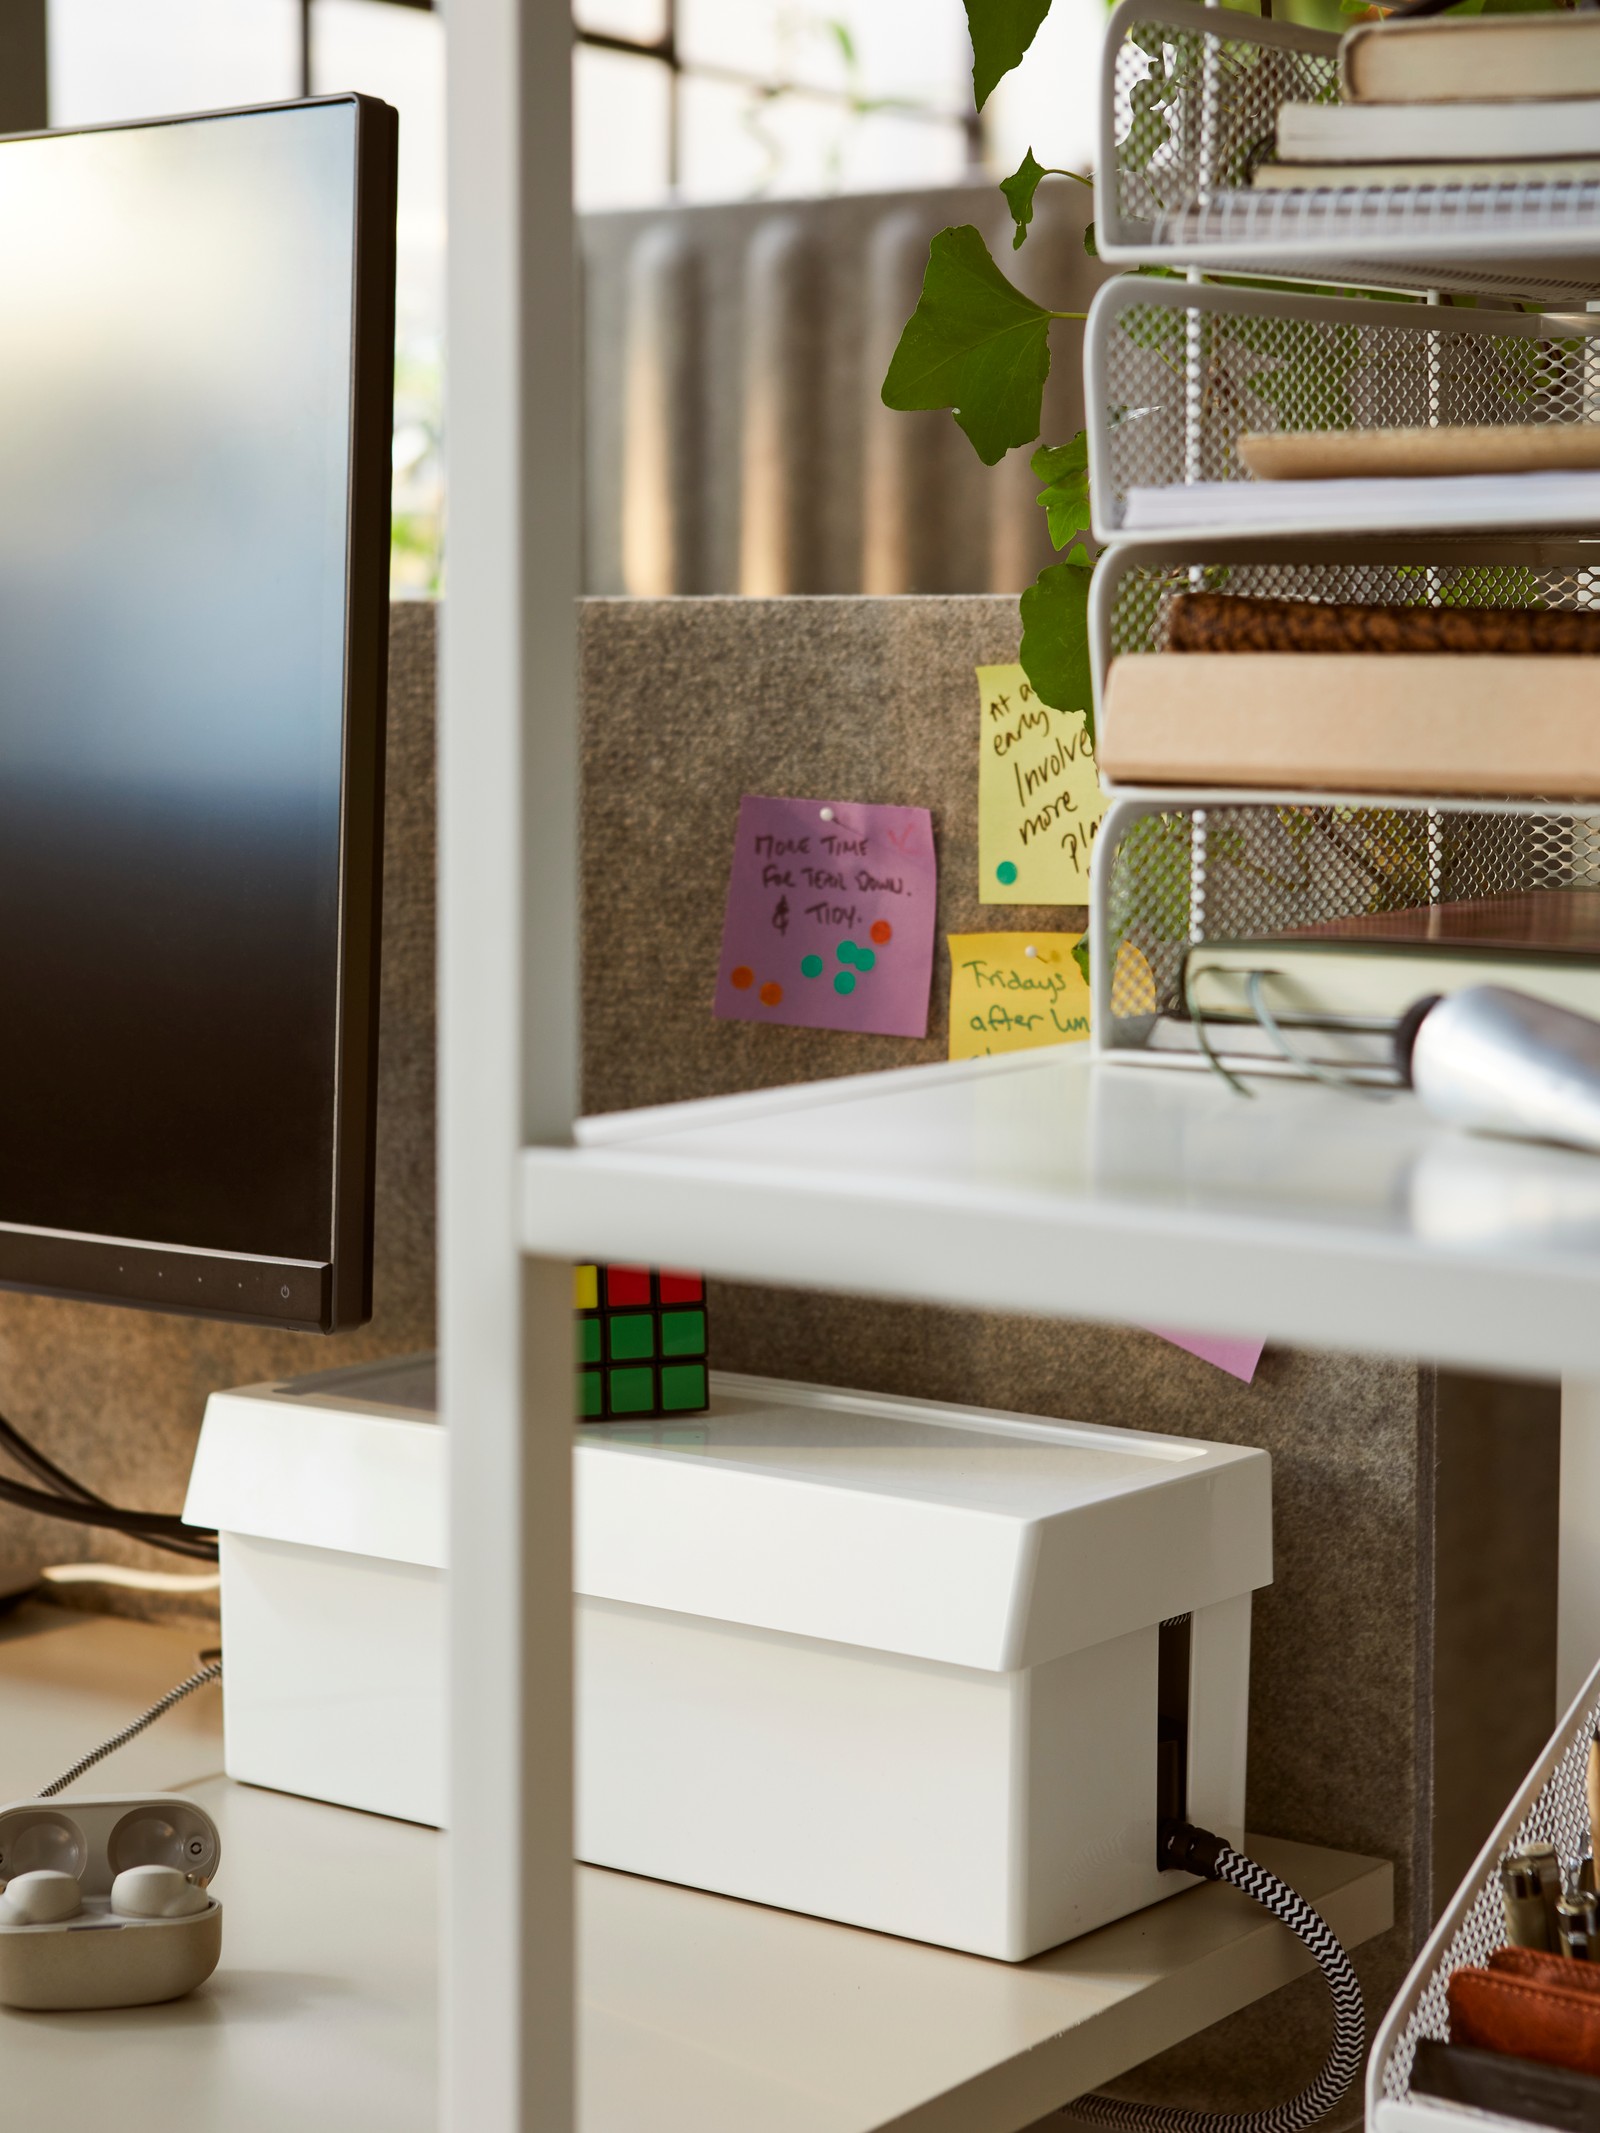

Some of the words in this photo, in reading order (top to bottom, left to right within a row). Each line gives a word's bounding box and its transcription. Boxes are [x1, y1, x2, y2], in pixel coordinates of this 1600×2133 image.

[989, 694, 1011, 722] At
[993, 710, 1050, 757] early
[1014, 728, 1094, 808] Involve
[1018, 791, 1078, 846] more
[755, 834, 810, 859] MORE
[820, 835, 870, 857] TIME
[1061, 814, 1102, 874] pla
[762, 864, 796, 888] FOR
[802, 867, 847, 892] TEAR
[855, 870, 912, 897] DOWN.
[771, 894, 790, 937] &
[804, 902, 862, 930] TIDY.
[961, 959, 1066, 1004] Fridays
[970, 1004, 1044, 1032] after
